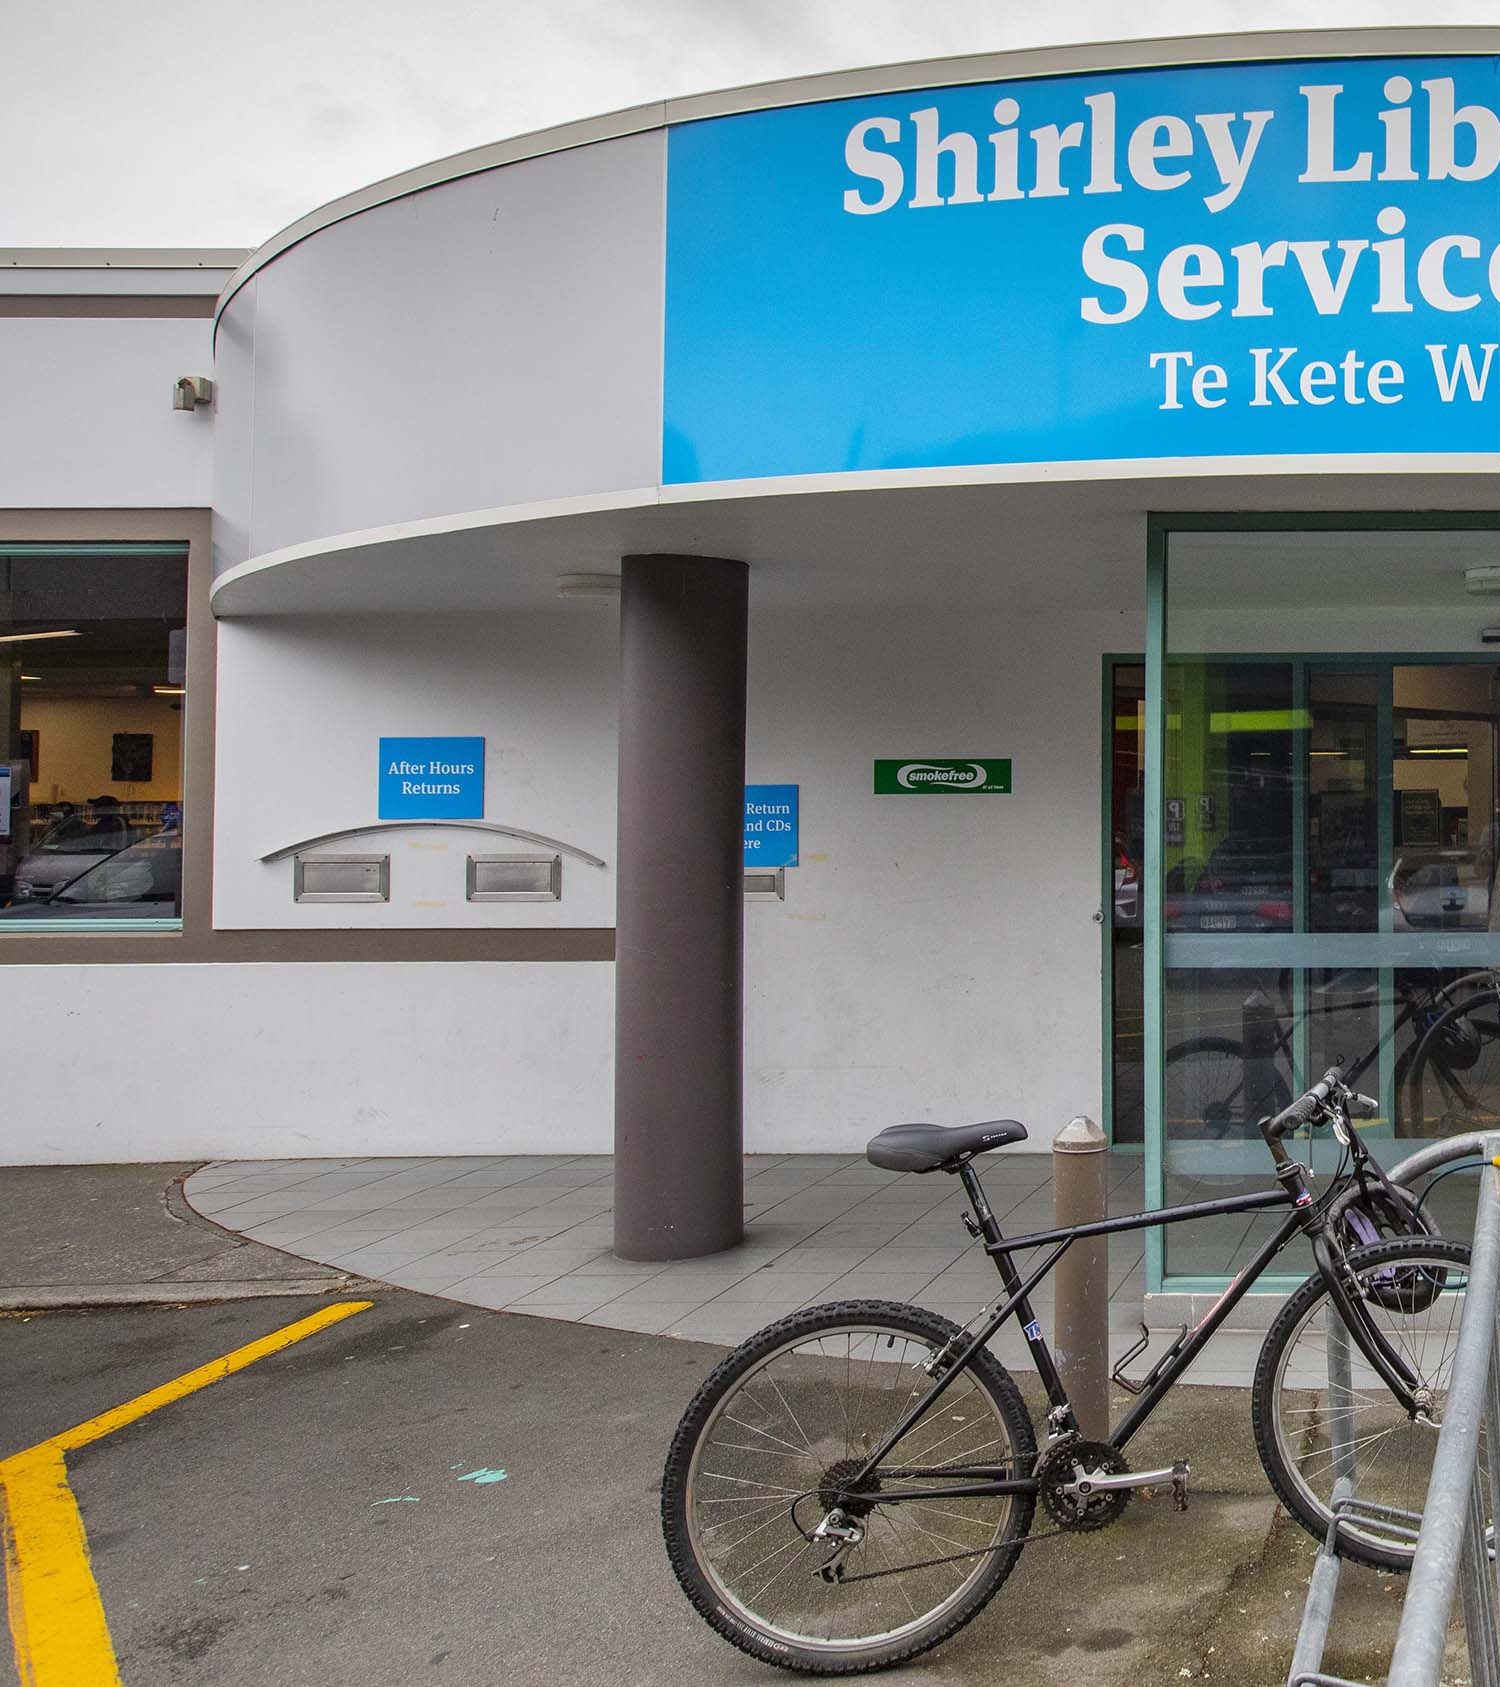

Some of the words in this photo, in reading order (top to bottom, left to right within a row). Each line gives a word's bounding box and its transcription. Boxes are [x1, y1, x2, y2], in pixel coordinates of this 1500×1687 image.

[844, 98, 1273, 215] Shirley
[1150, 352, 1227, 409] Te
[1250, 348, 1404, 405] Kete
[388, 761, 426, 775] After
[429, 761, 475, 775] Hours
[909, 770, 974, 781] smokefree
[402, 781, 461, 795] Returns
[746, 802, 790, 814] Return
[744, 819, 763, 832] nd
[766, 820, 791, 832] CDs
[744, 839, 761, 849] ere
